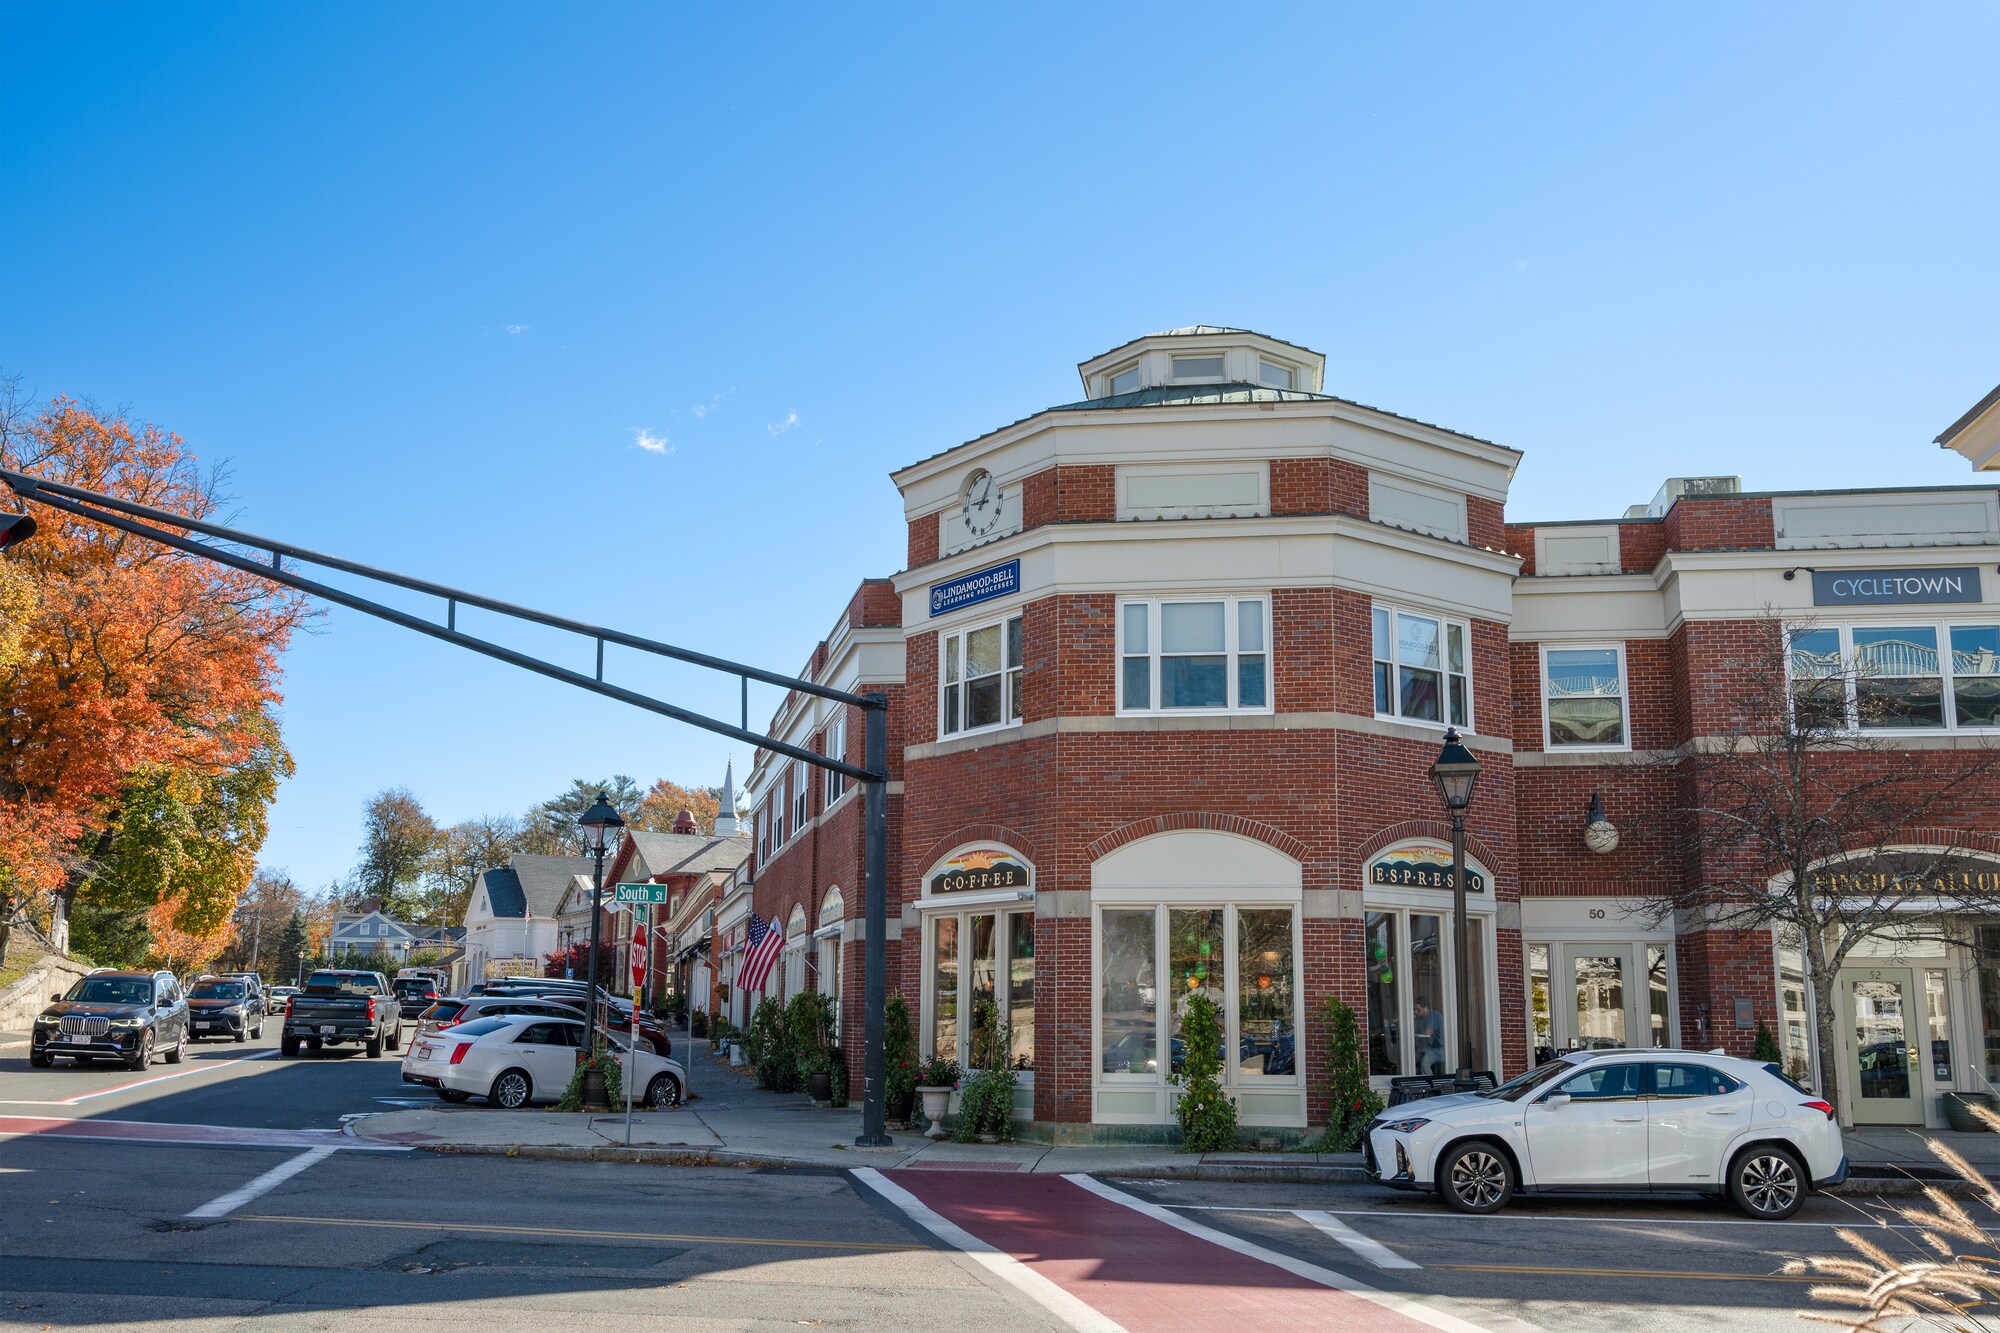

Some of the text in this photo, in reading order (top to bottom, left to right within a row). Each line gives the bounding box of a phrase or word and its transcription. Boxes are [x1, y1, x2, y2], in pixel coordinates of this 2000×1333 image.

[943, 568, 1014, 599] LINDAMOOD-BELL
[943, 580, 1014, 606] LEARNING PROCESSES
[1832, 576, 1963, 597] CYCLETOWN
[943, 871, 1014, 891] COFFEE
[1375, 867, 1481, 890] ESPRESO
[619, 885, 663, 901] South St
[1589, 909, 1605, 919] 50
[632, 942, 646, 969] STOP
[1869, 970, 1881, 980] 52
